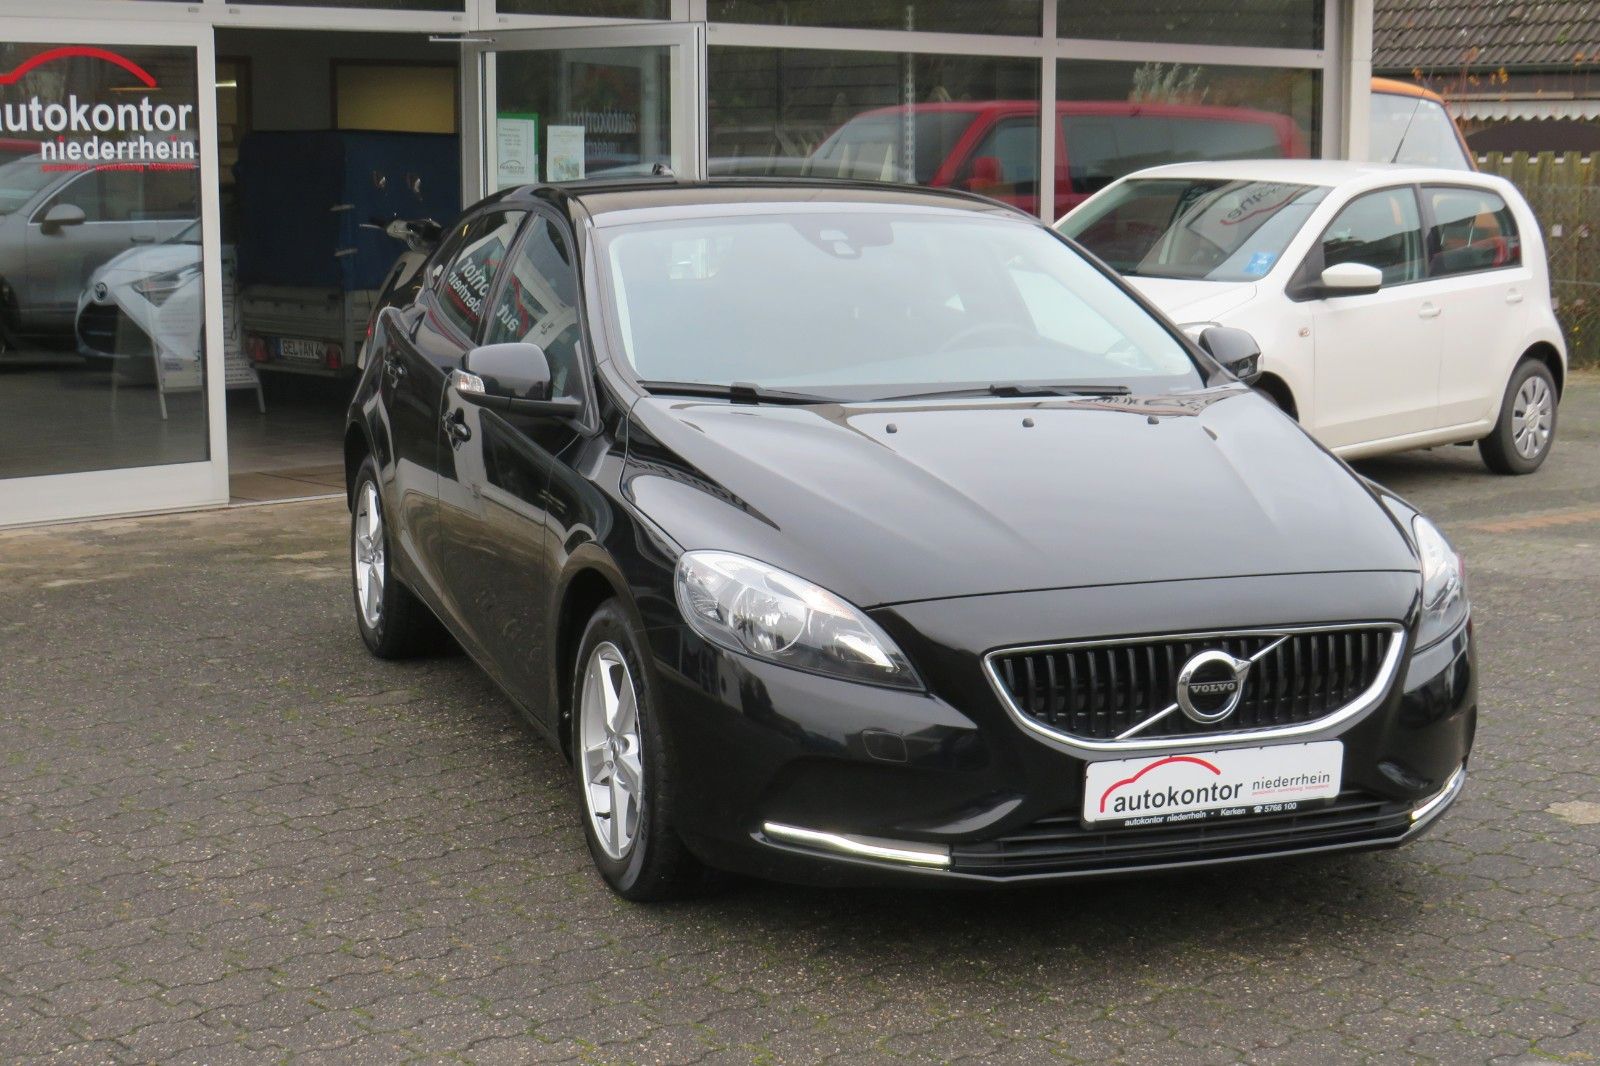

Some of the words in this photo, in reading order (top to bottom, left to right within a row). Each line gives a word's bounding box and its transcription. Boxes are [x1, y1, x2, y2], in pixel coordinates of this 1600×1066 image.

[0, 95, 192, 132] utokontor
[41, 135, 195, 161] niederrhein
[1190, 683, 1236, 694] VOLVO
[1113, 782, 1244, 813] autokontor
[1252, 771, 1331, 790] niederrhein
[1125, 815, 1164, 826] autokontor
[1166, 811, 1206, 822] niederrhein
[1220, 807, 1246, 816] Kerken
[1284, 802, 1297, 810] 100
